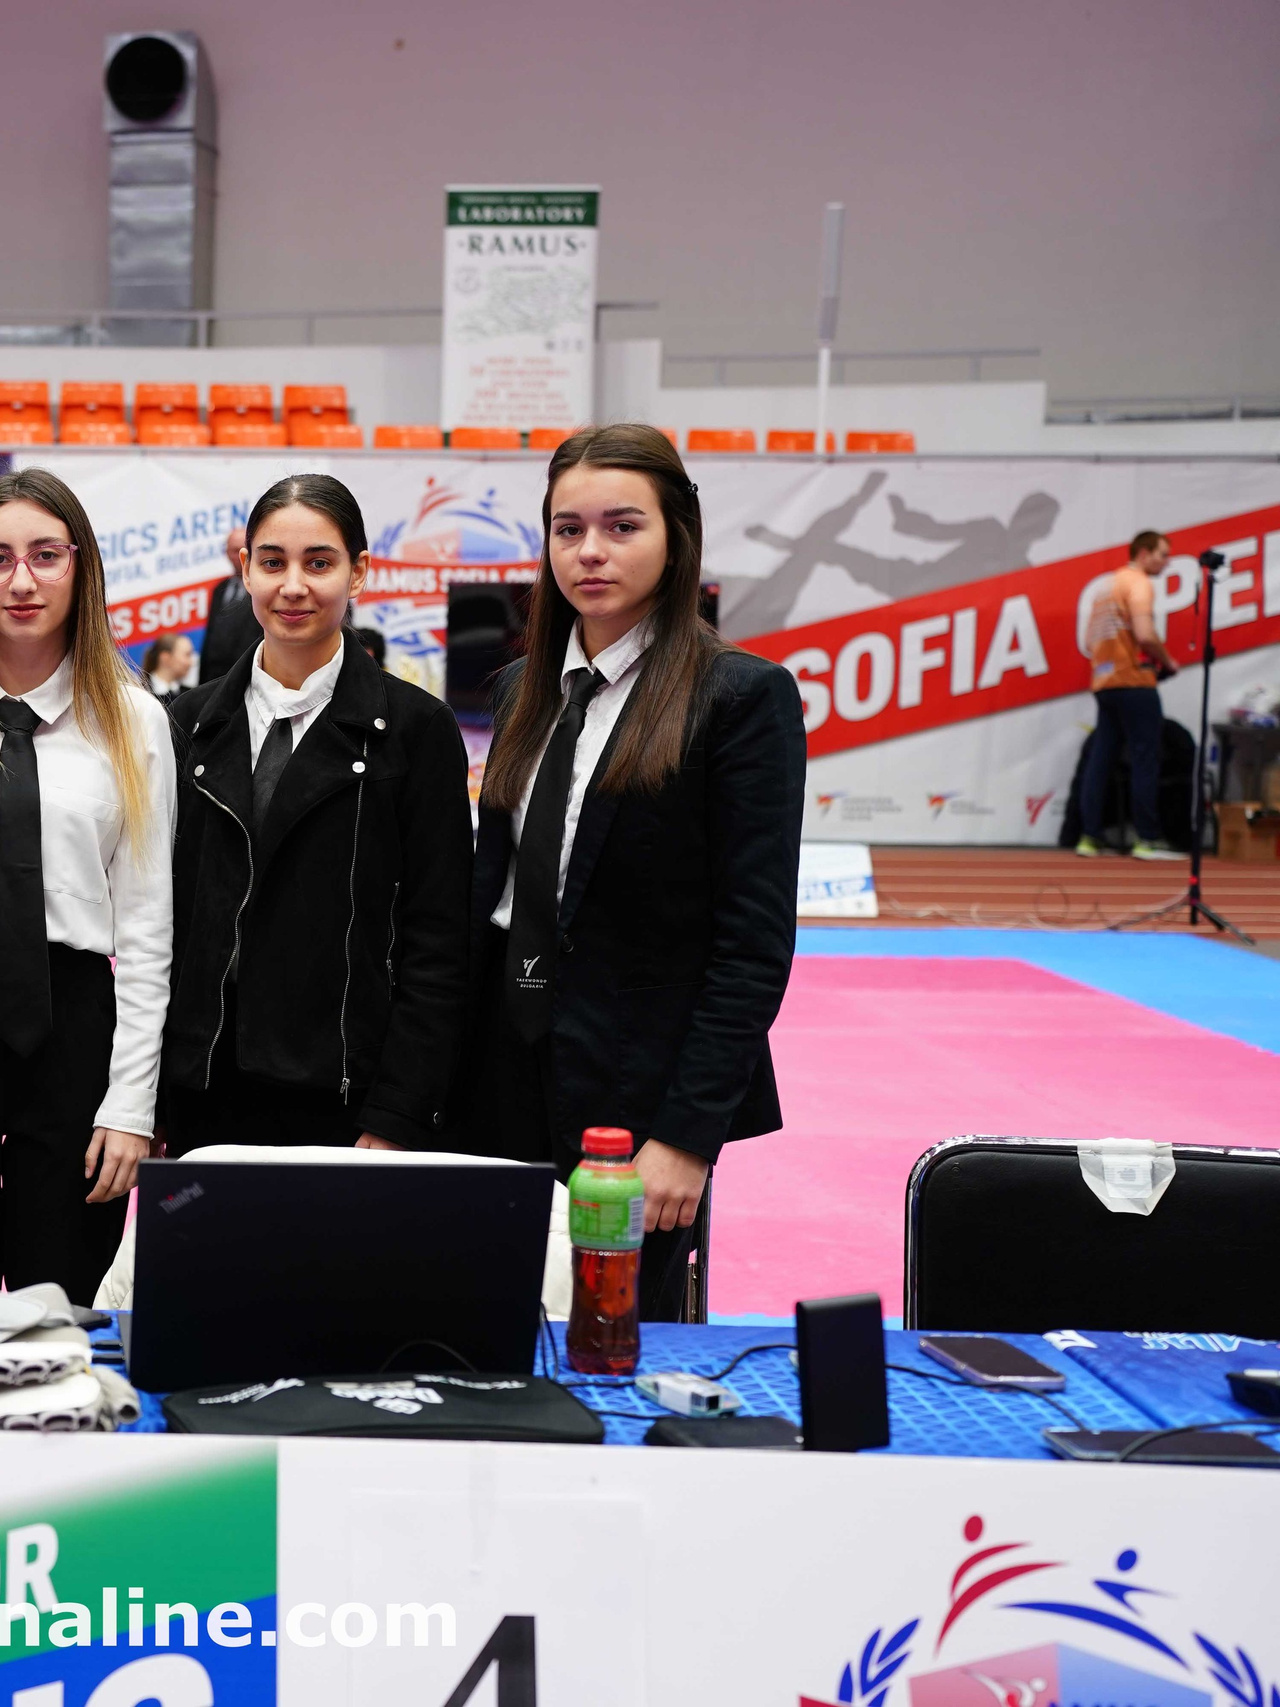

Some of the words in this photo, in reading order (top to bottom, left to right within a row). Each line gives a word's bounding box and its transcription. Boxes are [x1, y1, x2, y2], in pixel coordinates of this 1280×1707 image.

[457, 205, 587, 223] LABORATORY
[467, 232, 579, 257] RAMUS
[98, 520, 159, 563] SICS
[168, 499, 250, 547] AREN
[138, 586, 209, 634] SOFI
[782, 594, 1049, 734] SOFIA
